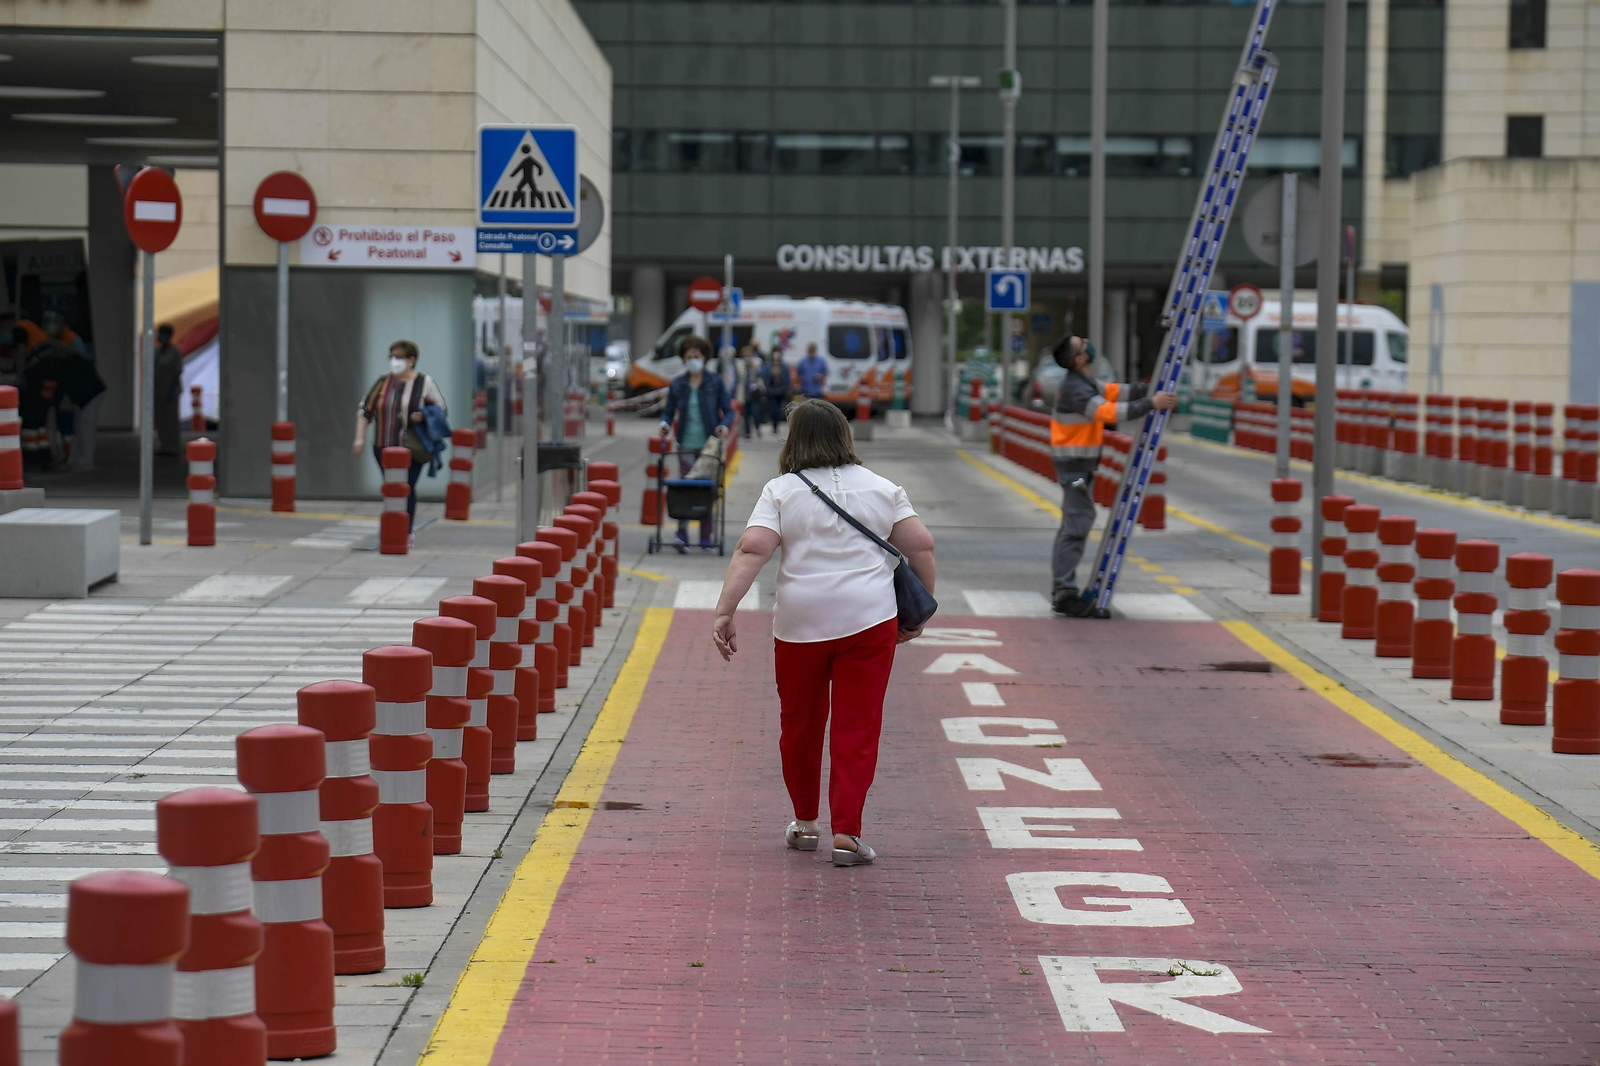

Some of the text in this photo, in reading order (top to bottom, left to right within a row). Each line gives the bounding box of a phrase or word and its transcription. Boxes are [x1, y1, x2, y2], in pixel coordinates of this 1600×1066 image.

[339, 228, 456, 243] Prohibido el Paso
[479, 232, 507, 241] Entrada
[368, 245, 428, 259] Peatonal
[777, 243, 935, 272] CONSULTAS
